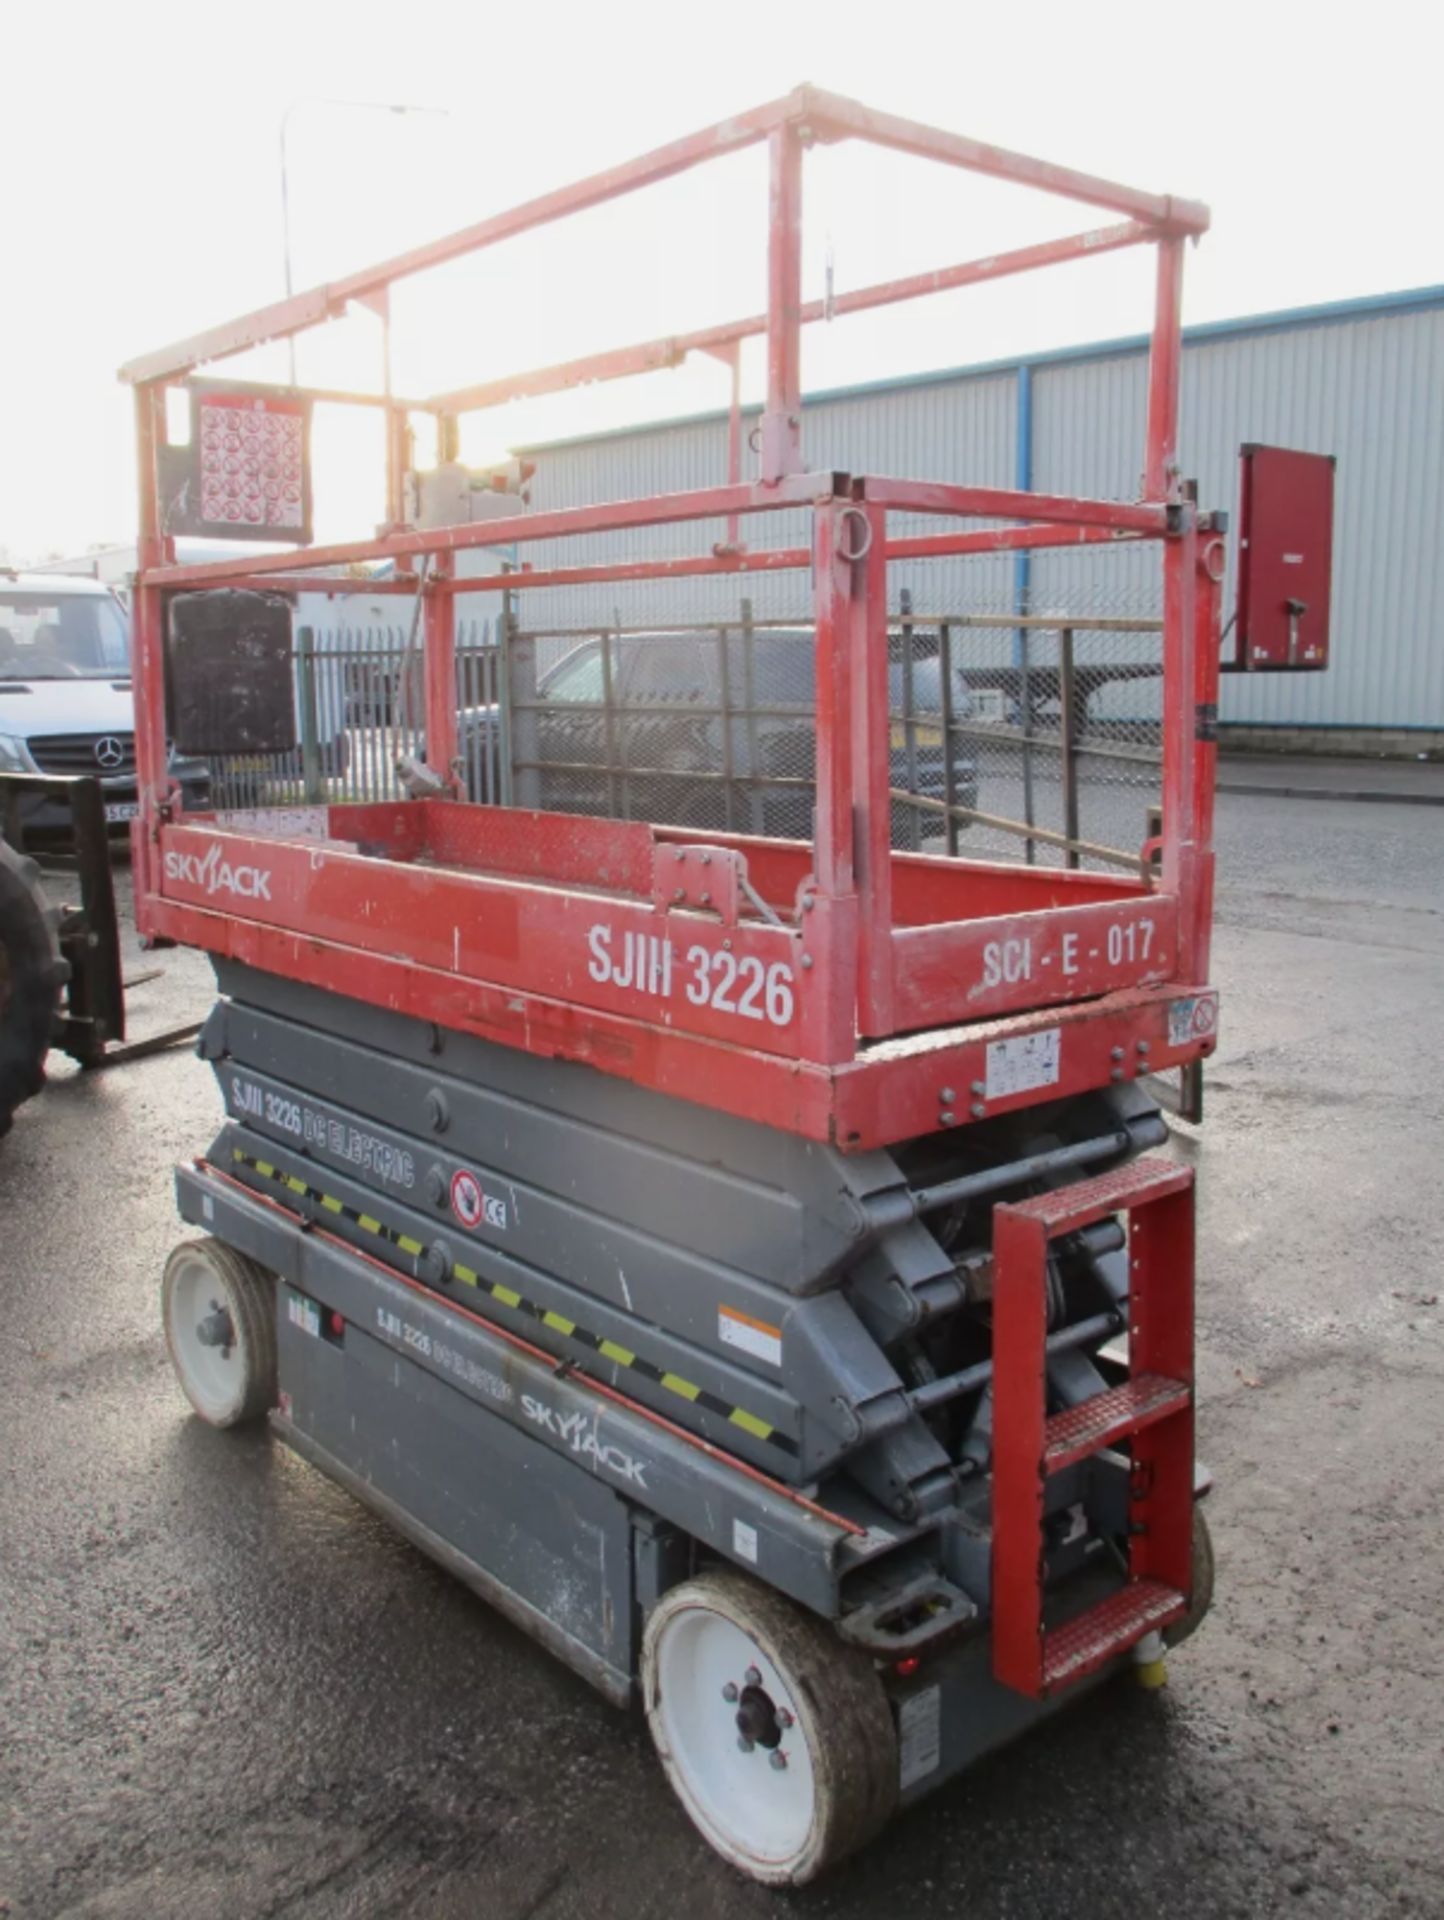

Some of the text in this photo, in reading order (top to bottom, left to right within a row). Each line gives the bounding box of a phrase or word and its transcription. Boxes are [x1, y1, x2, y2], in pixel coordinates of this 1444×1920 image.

[165, 841, 271, 901] SKYJACK
[686, 945, 794, 1026] 3226
[983, 937, 1032, 987] SCI
[1063, 933, 1079, 974] E
[1108, 919, 1155, 965] 017
[265, 1091, 301, 1136] 3226
[521, 1394, 649, 1488] SKYJACK
